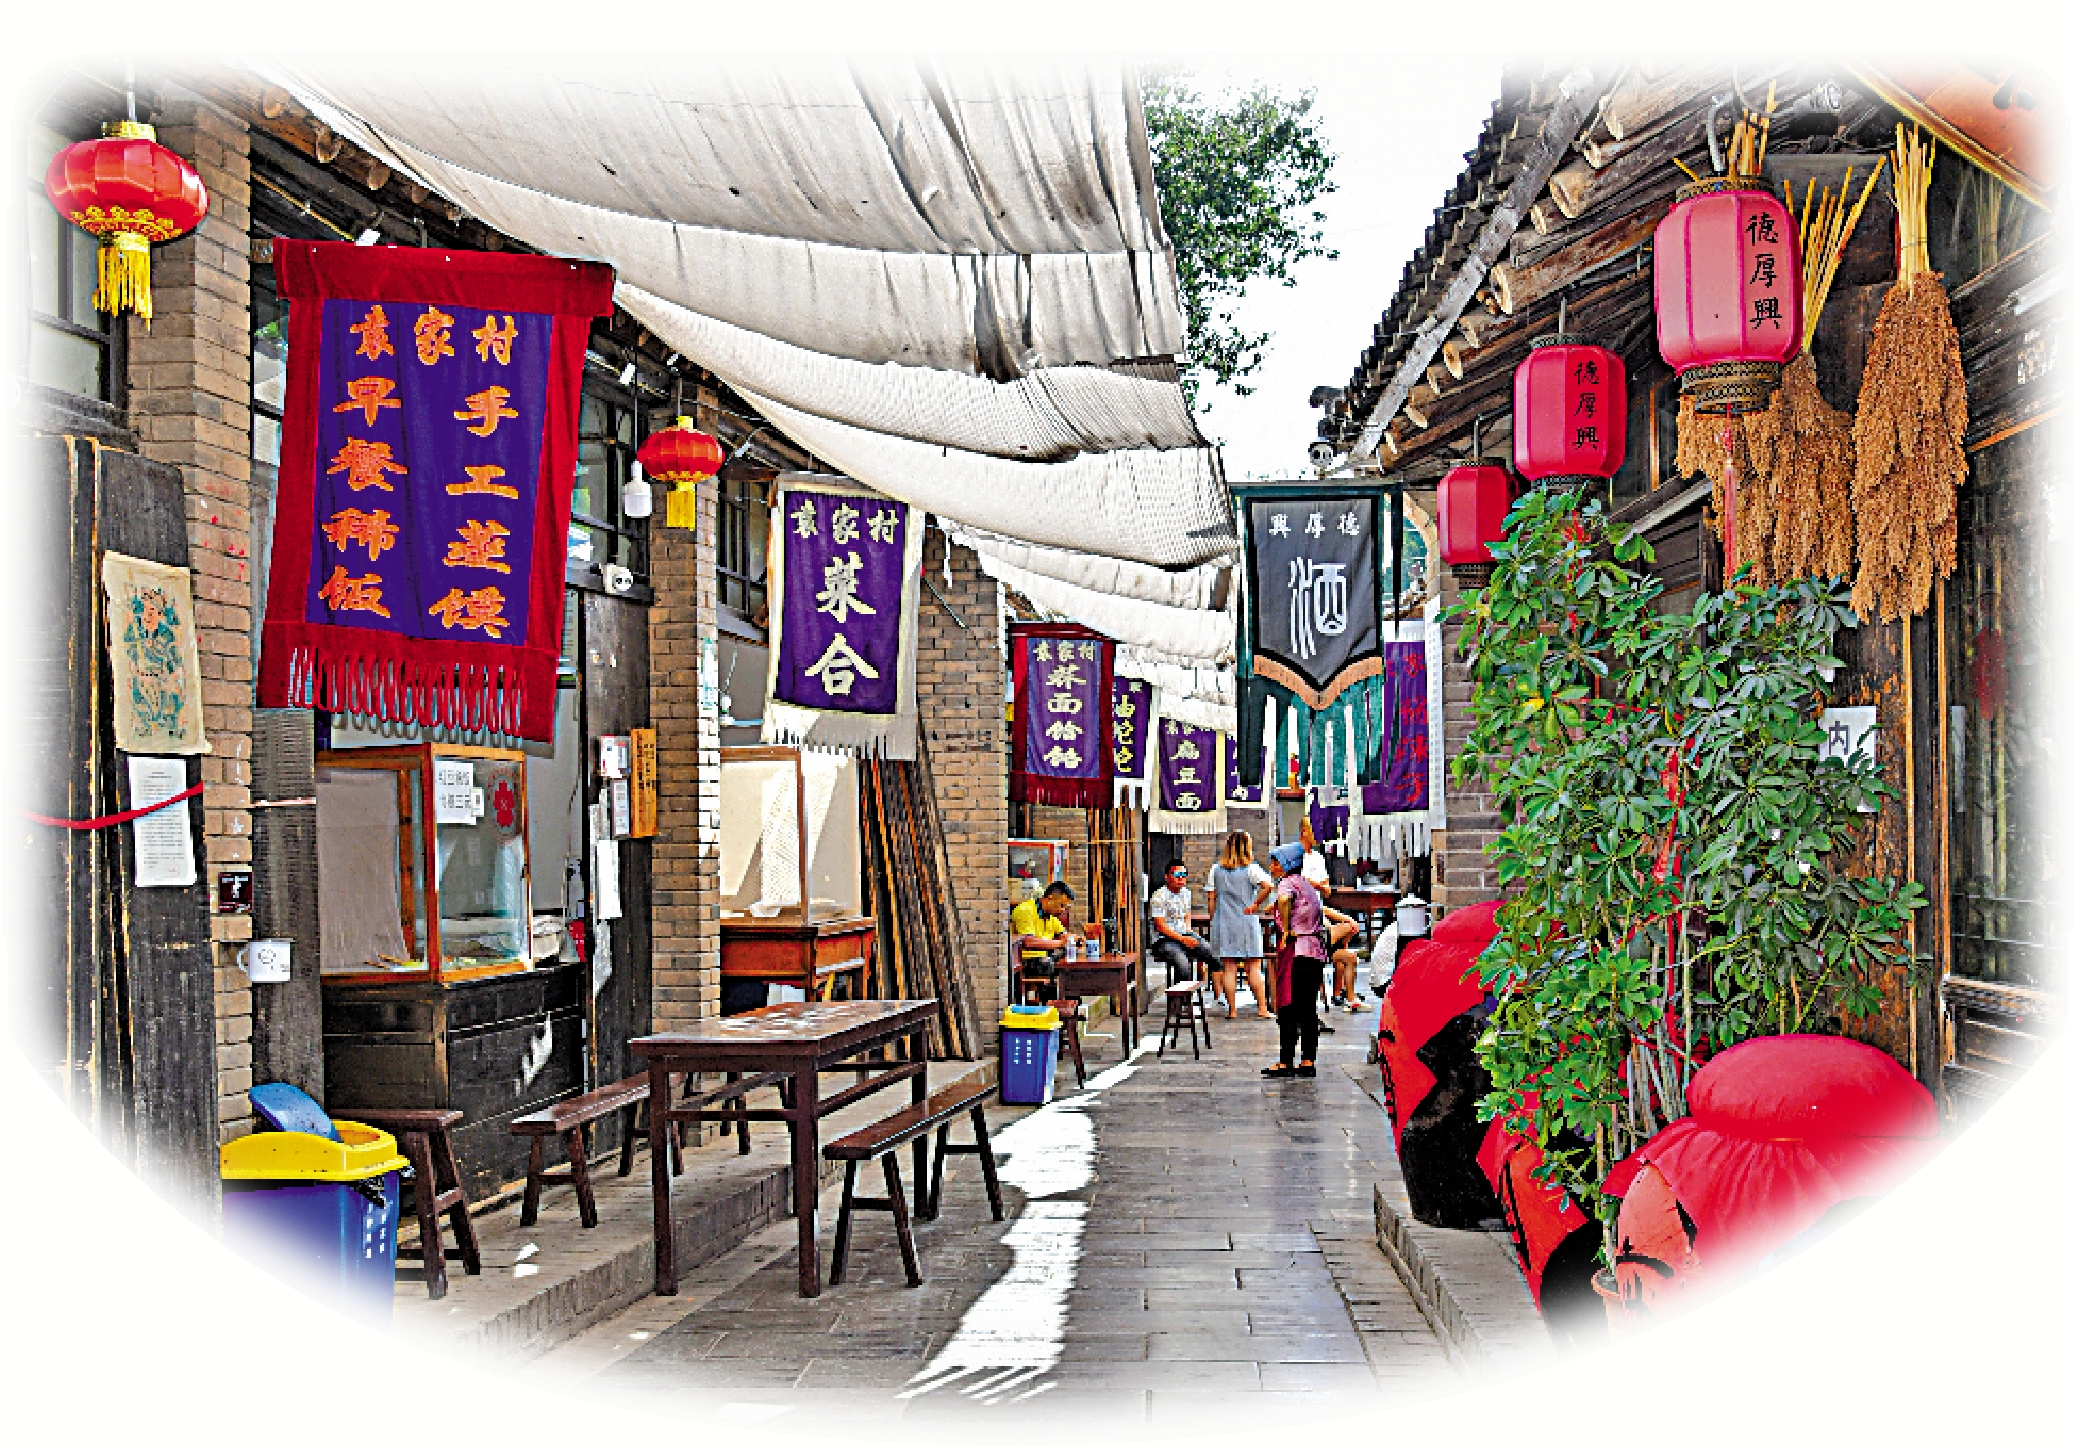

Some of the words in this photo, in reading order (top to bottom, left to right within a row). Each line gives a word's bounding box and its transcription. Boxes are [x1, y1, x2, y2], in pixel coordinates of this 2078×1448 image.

[1746, 212, 1783, 331] 德厚興
[349, 304, 518, 365] 袁家村
[1573, 360, 1601, 452] 德厚興
[318, 375, 408, 618] 早餐稀饭
[790, 499, 900, 545] 袁家村
[804, 551, 879, 696] 菜合
